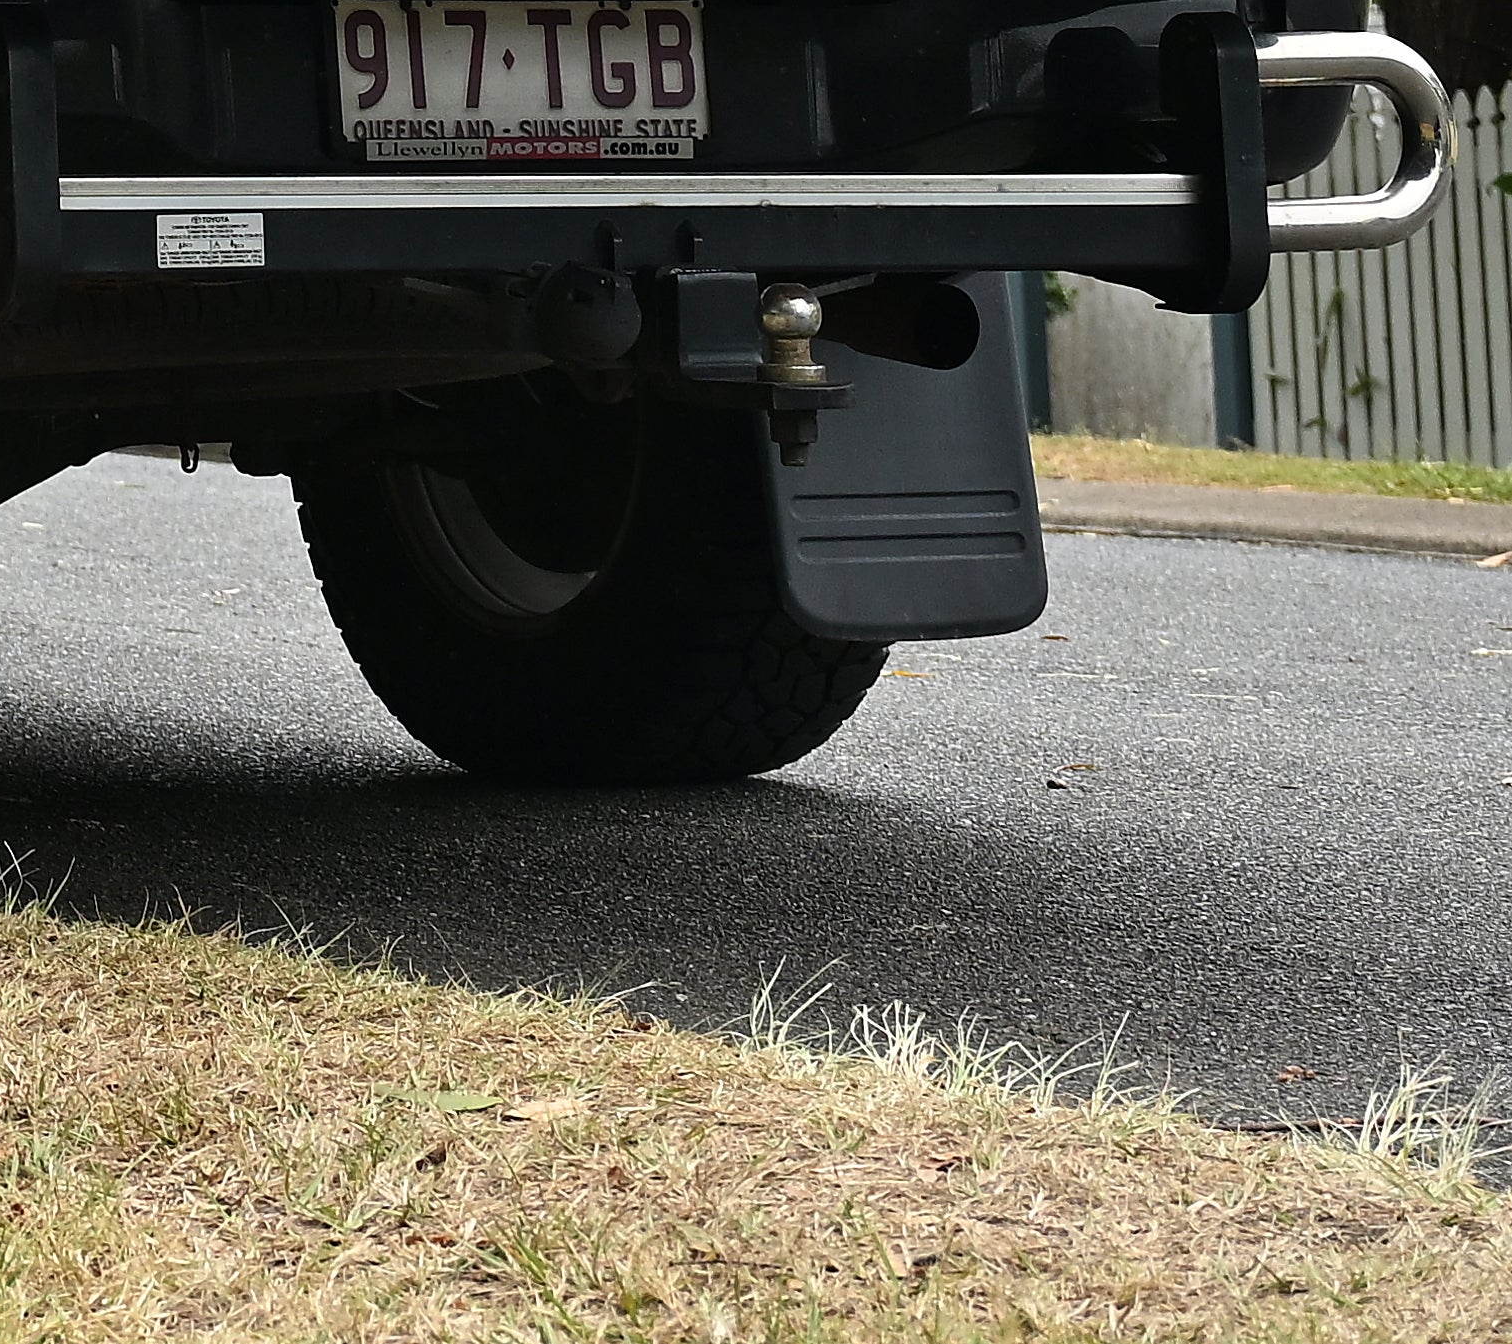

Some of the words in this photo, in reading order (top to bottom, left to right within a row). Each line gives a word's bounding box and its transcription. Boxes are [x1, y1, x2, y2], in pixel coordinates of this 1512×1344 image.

[353, 118, 495, 139] QUEENSLAND
[519, 118, 624, 138] SUNSHINE
[636, 118, 697, 137] STATE
